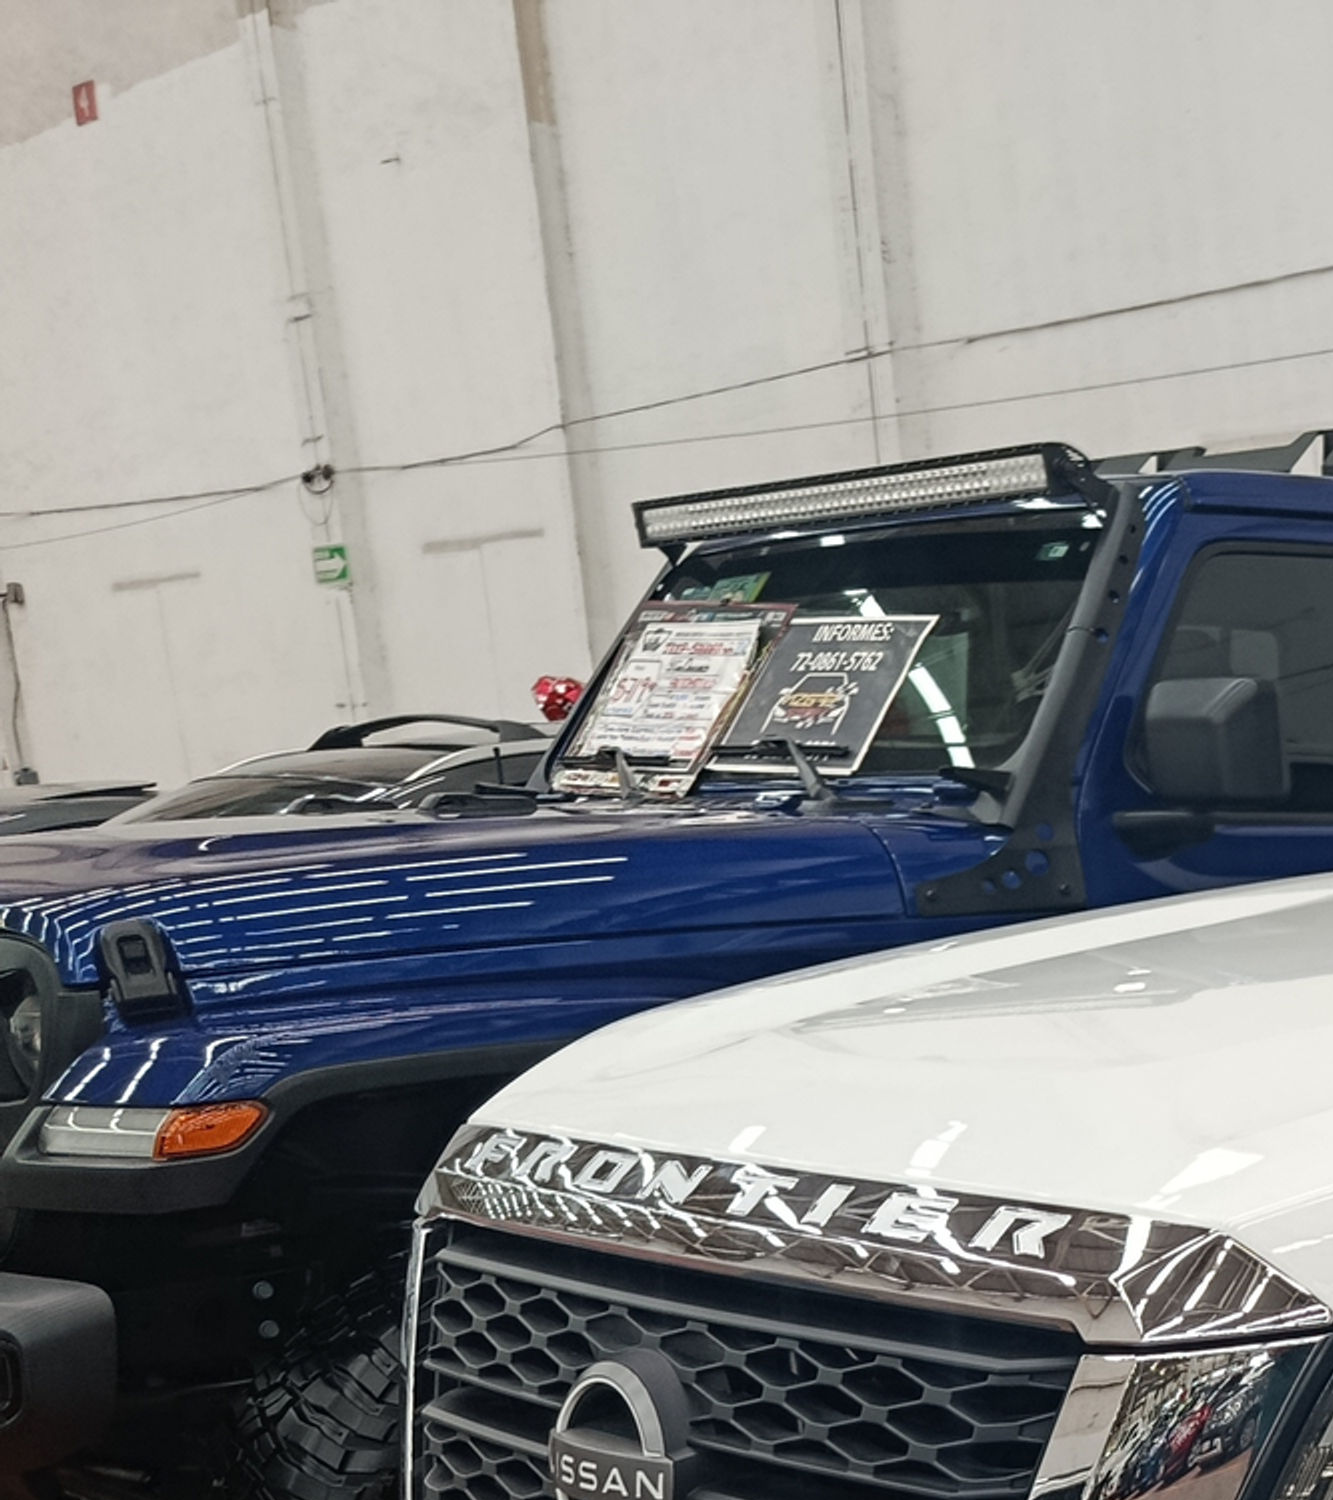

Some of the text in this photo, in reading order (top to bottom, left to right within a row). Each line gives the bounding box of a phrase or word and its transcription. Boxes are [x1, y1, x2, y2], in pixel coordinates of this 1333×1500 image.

[812, 622, 895, 642] INFORMES:
[464, 1128, 1072, 1259] FRONTIER
[555, 1452, 664, 1500] SSAN
